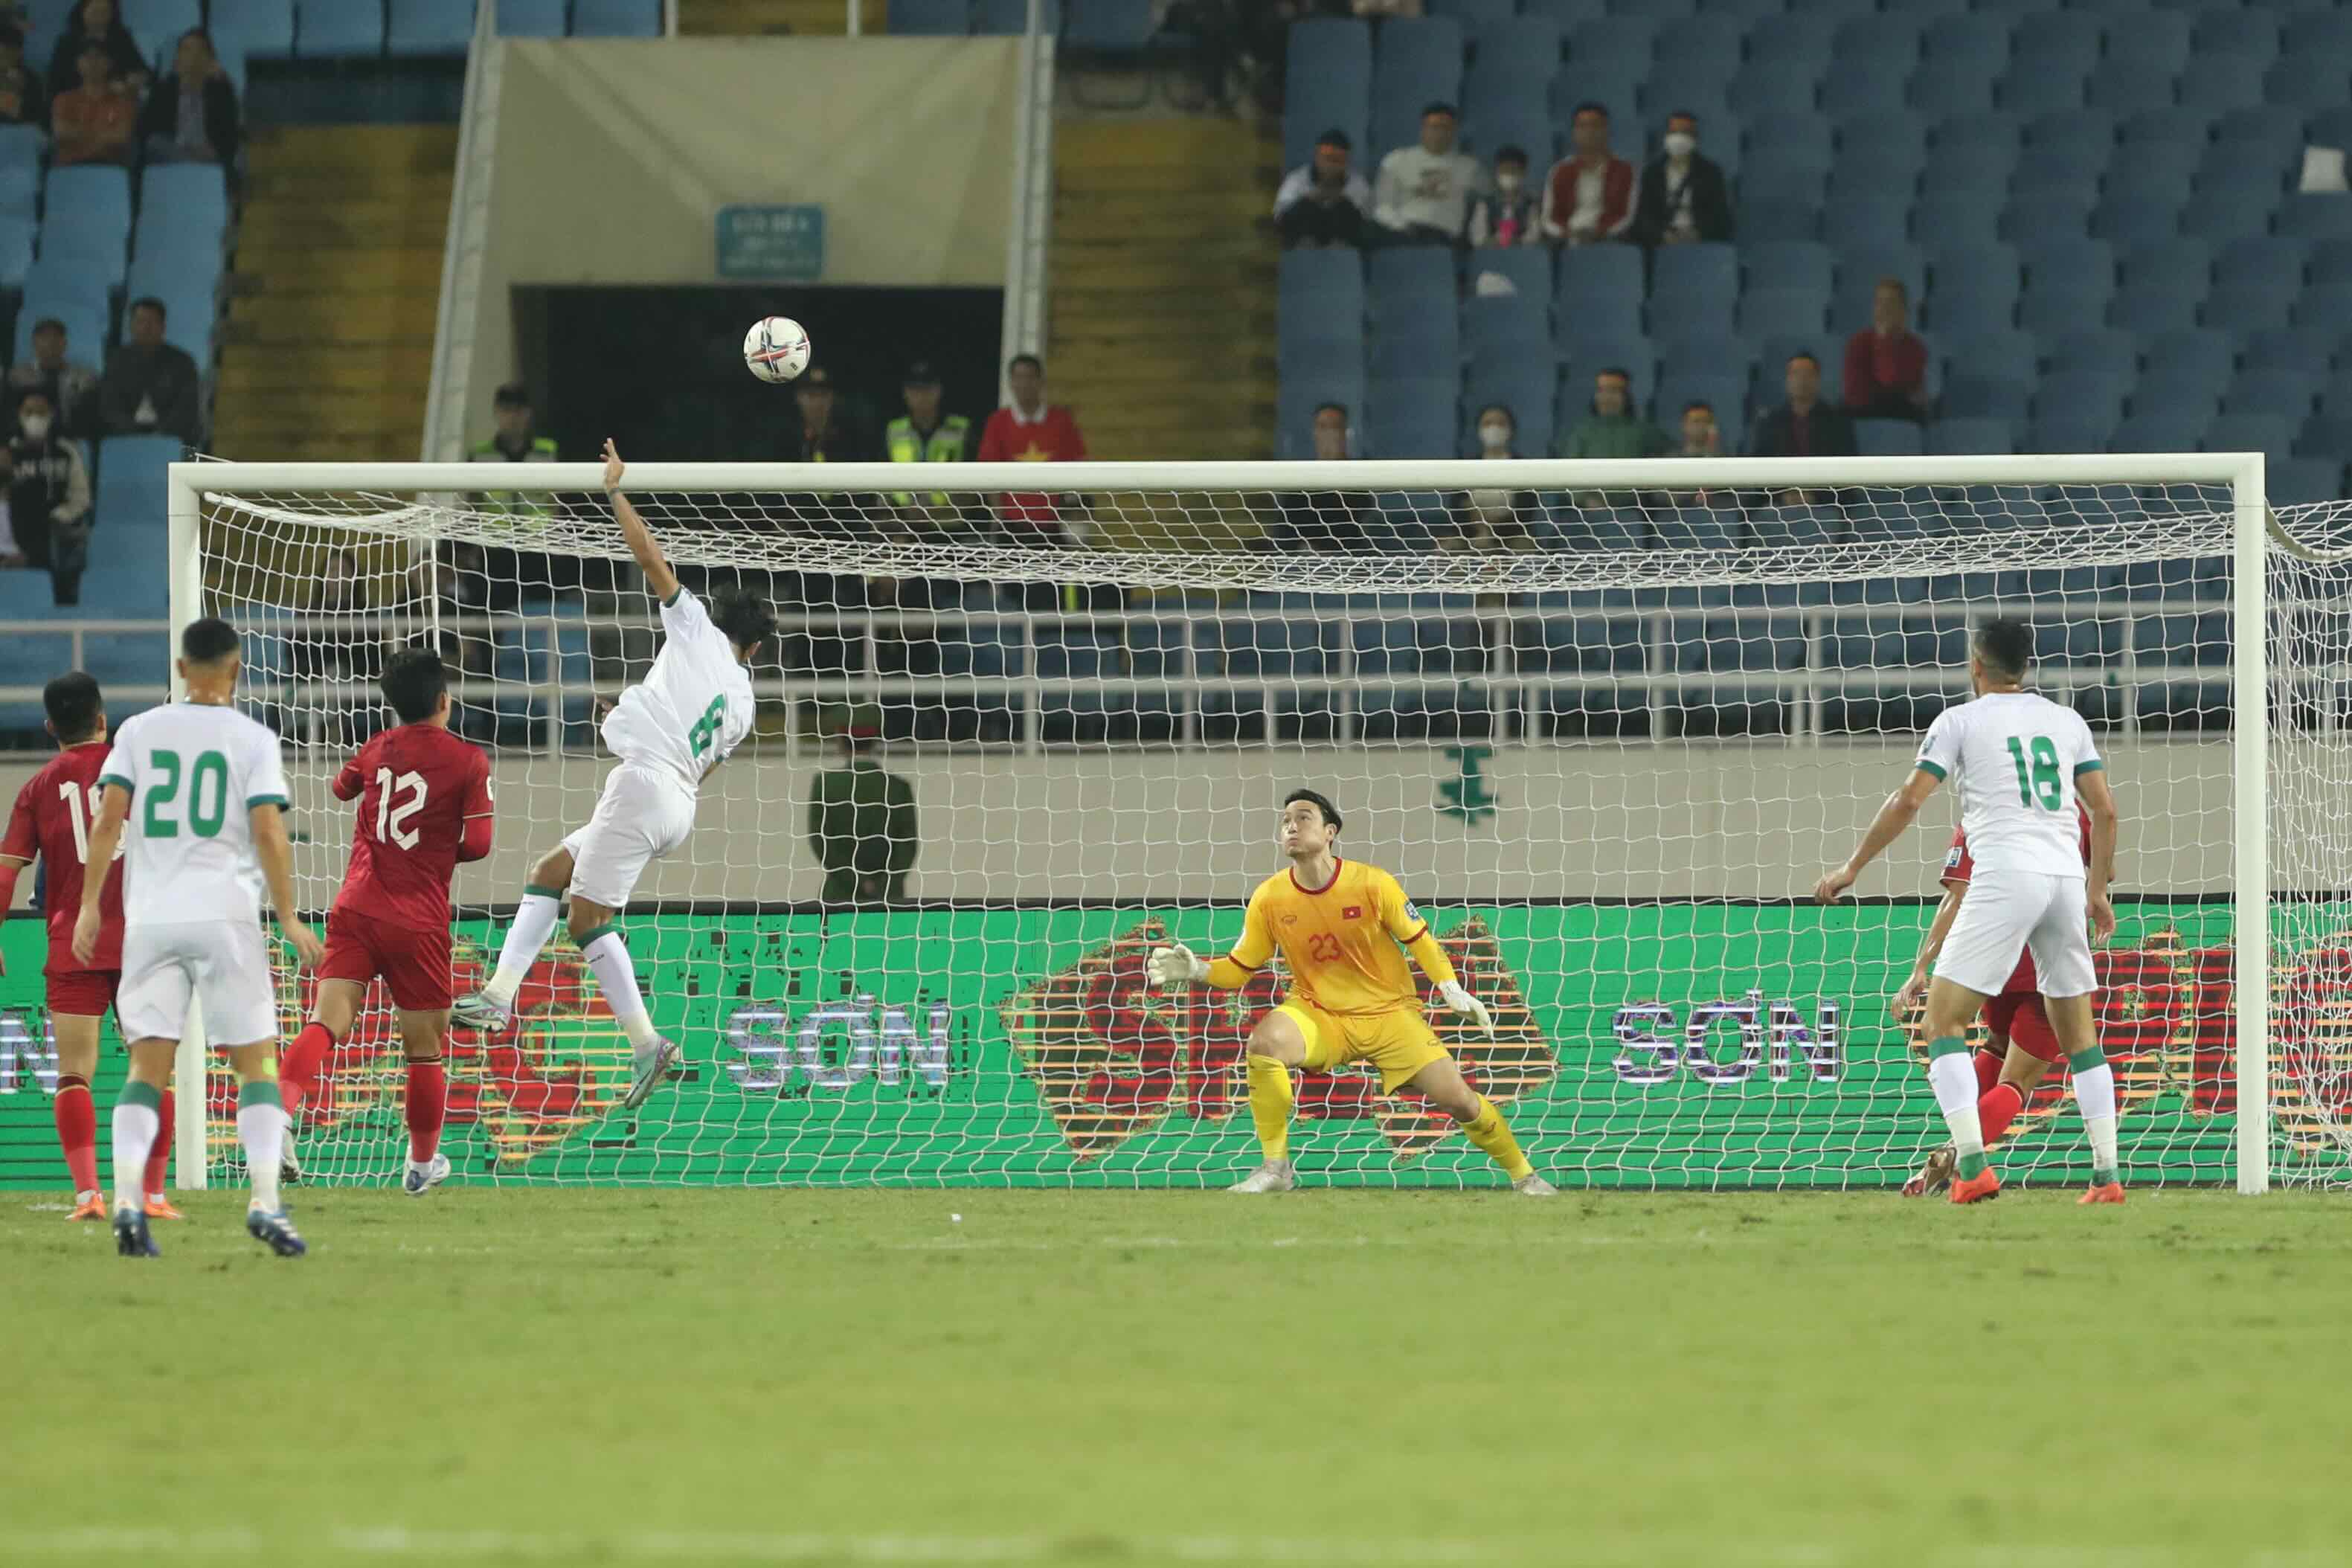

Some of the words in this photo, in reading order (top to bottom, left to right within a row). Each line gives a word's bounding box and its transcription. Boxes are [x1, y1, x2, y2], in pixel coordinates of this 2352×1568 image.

[144, 750, 228, 838] 20
[376, 767, 428, 851] 12
[2006, 736, 2061, 811] 18
[1308, 933, 1340, 963] 23
